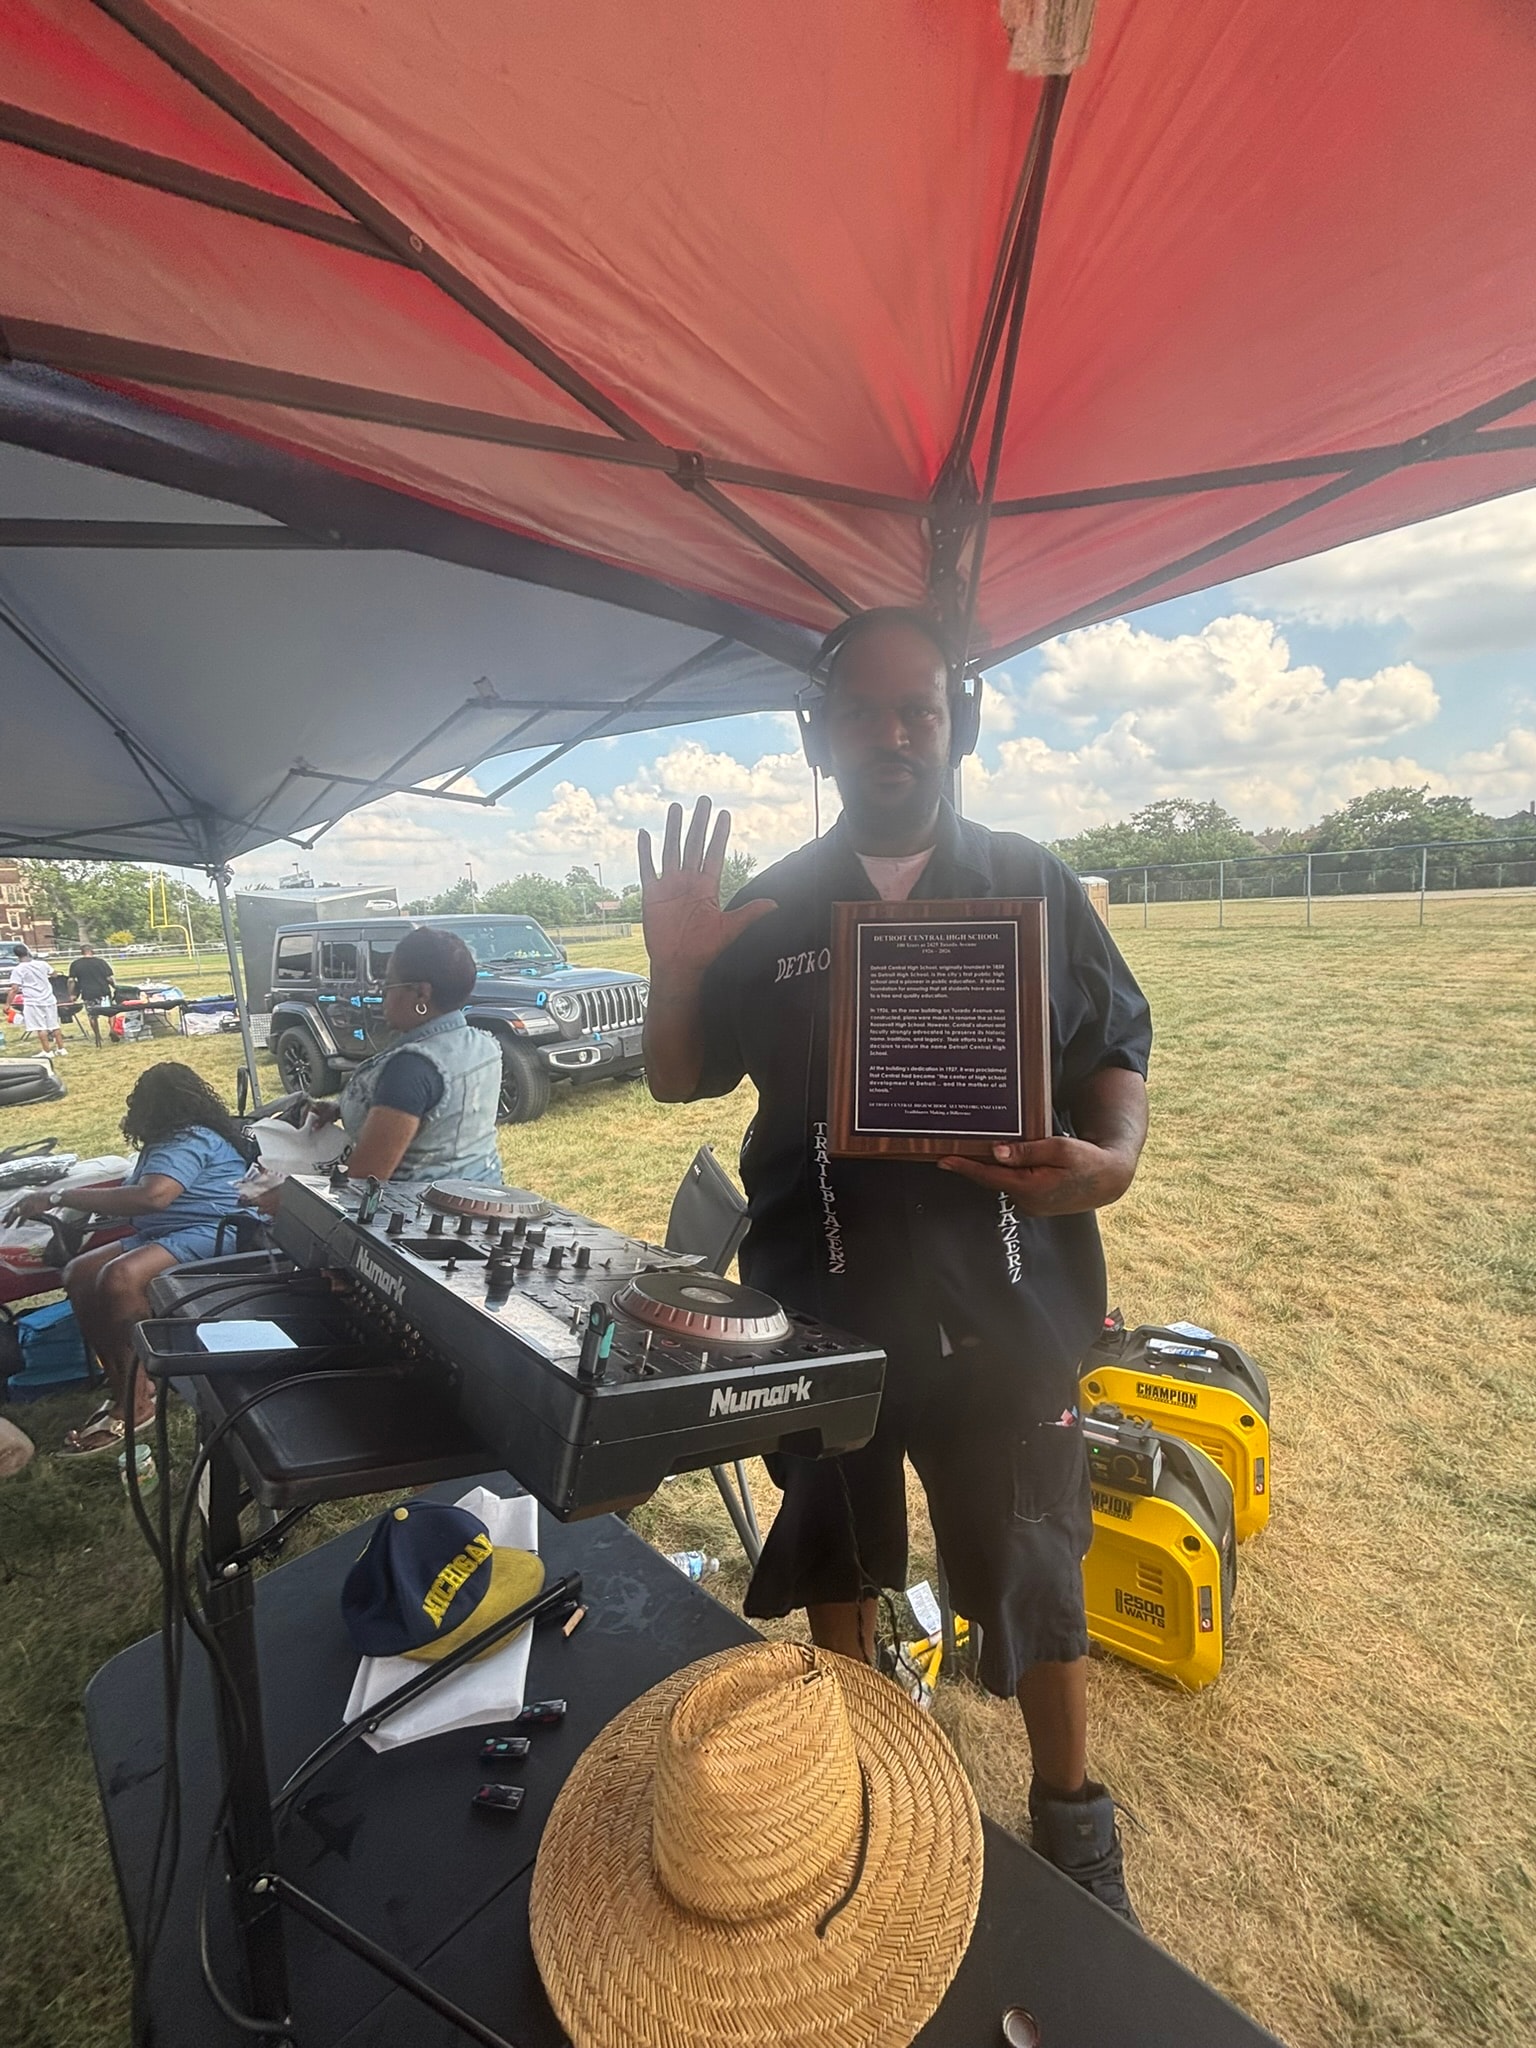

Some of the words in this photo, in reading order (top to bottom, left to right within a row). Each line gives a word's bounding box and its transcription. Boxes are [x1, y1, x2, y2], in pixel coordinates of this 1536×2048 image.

[775, 947, 831, 983] DETRO
[813, 1122, 845, 1274] TRAILBLAZERZ
[356, 1245, 407, 1306] Numark
[709, 1376, 812, 1417] Numark
[1136, 1382, 1197, 1405] CHAMPION
[422, 1533, 493, 1629] MICHIGAN
[1124, 1592, 1165, 1618] 2500
[1124, 1605, 1165, 1629] WATTS
